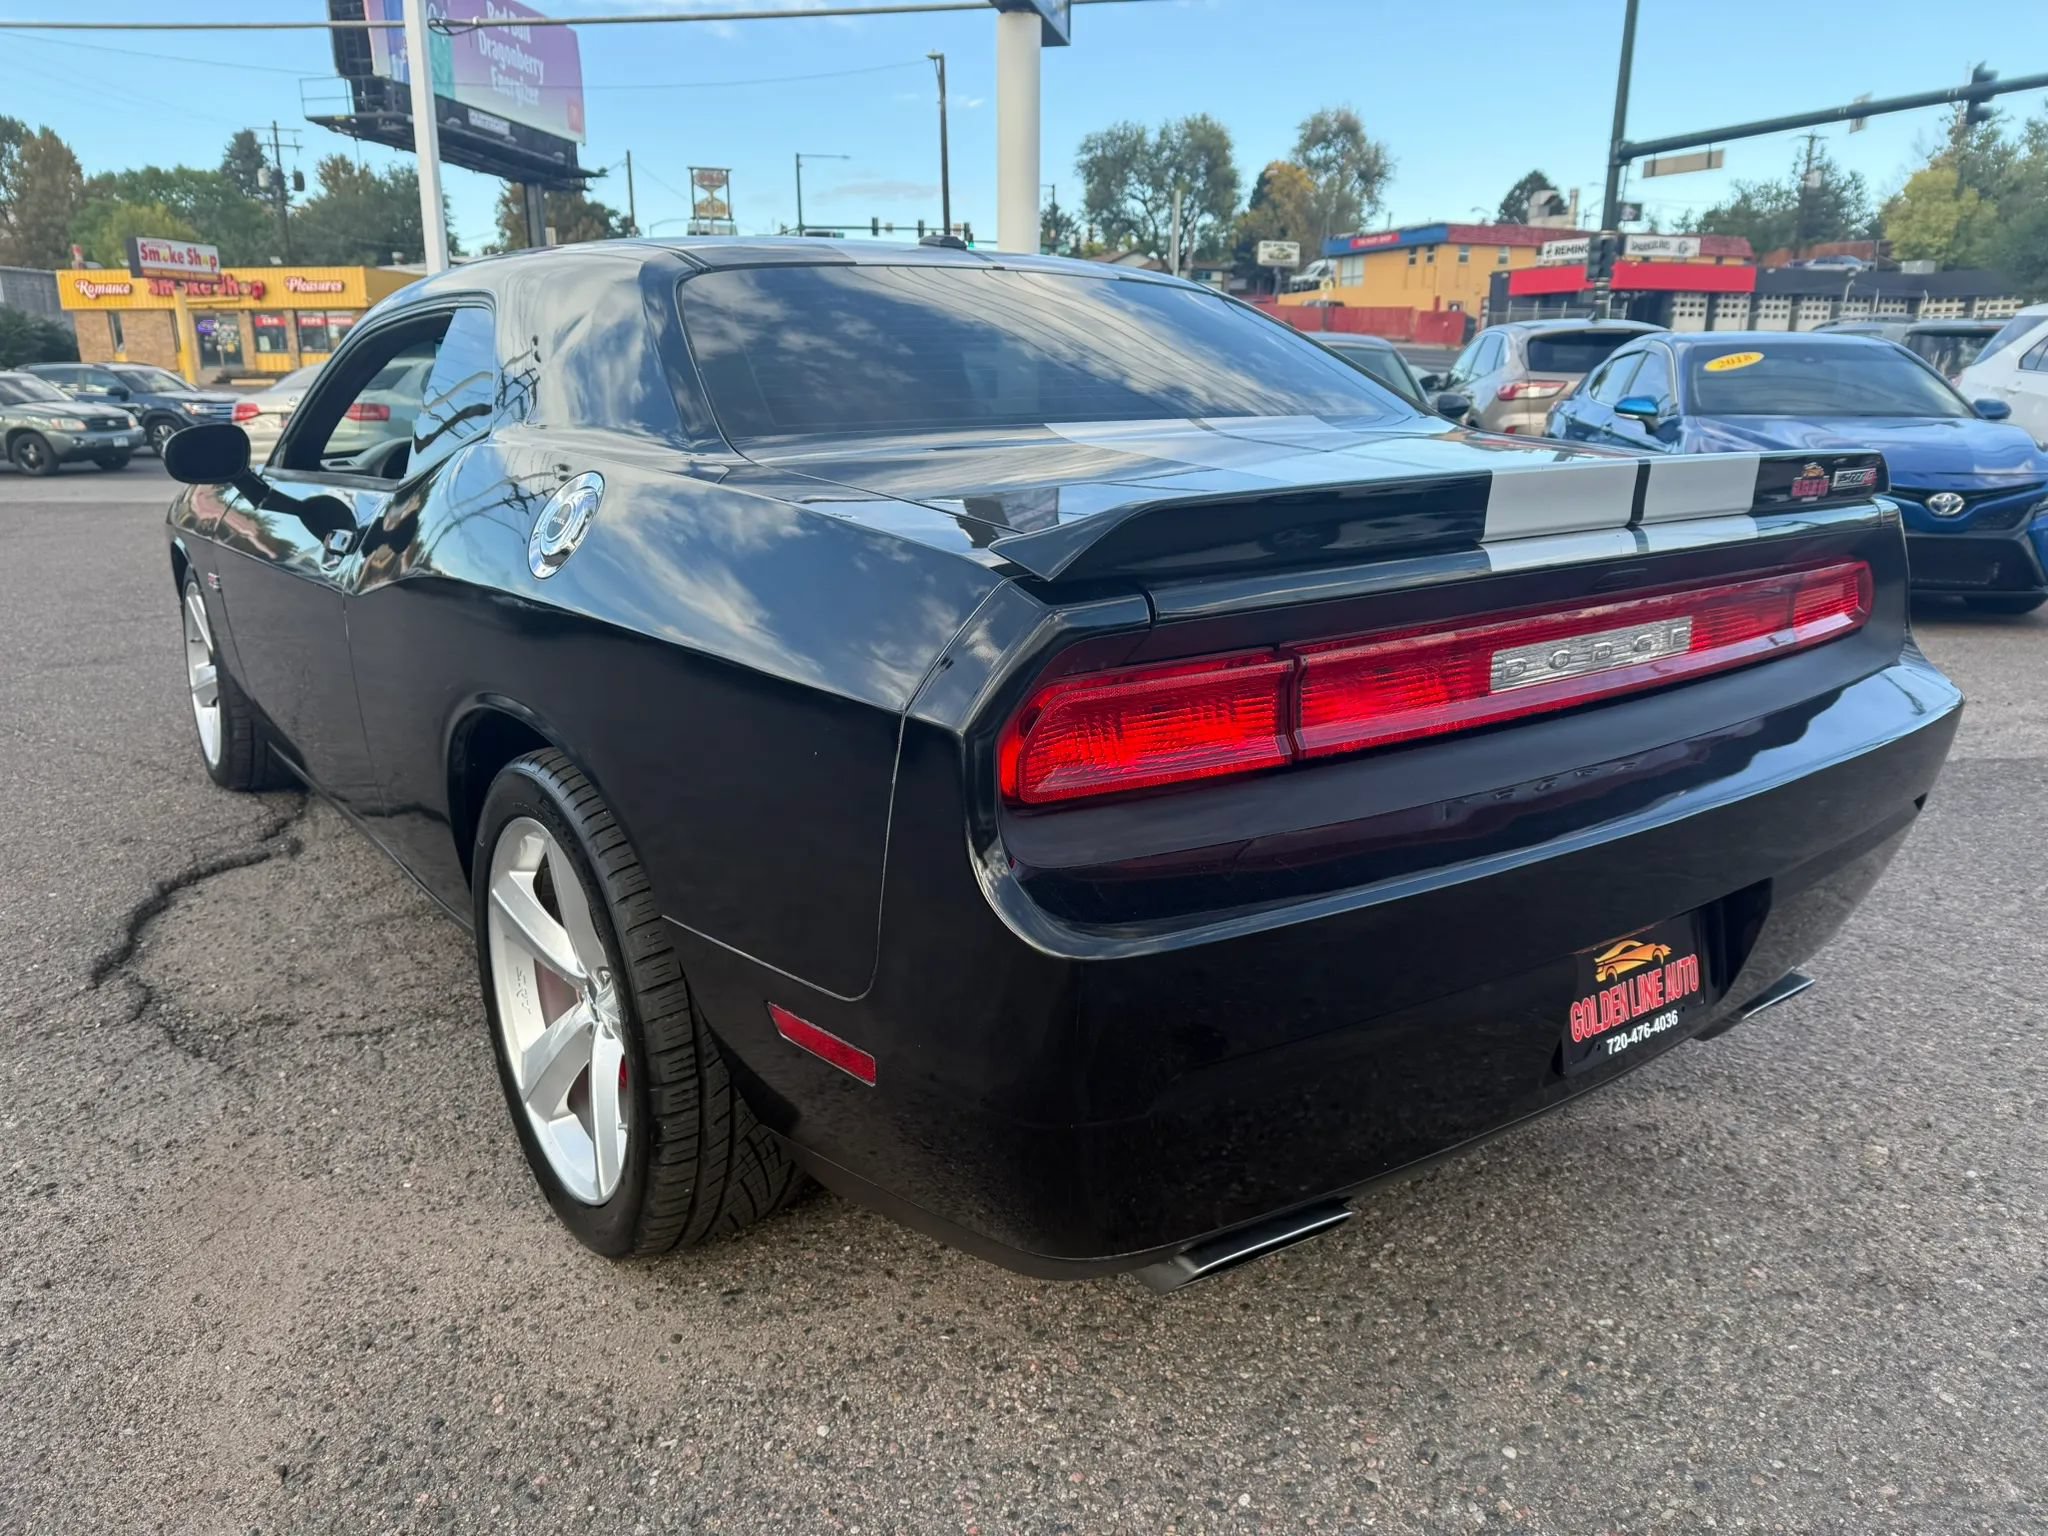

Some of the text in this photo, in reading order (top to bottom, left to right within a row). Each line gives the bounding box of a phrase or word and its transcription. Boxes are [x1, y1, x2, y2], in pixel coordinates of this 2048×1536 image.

[478, 28, 544, 85] Dragonberry
[490, 65, 540, 108] Energizer
[75, 279, 132, 299] Romance
[286, 276, 343, 293] Pleasures
[1502, 626, 1688, 680] DODGE
[1570, 953, 1699, 1042] GOLDEN LINE AUTO
[1606, 1009, 1679, 1055] 720-476-4036
